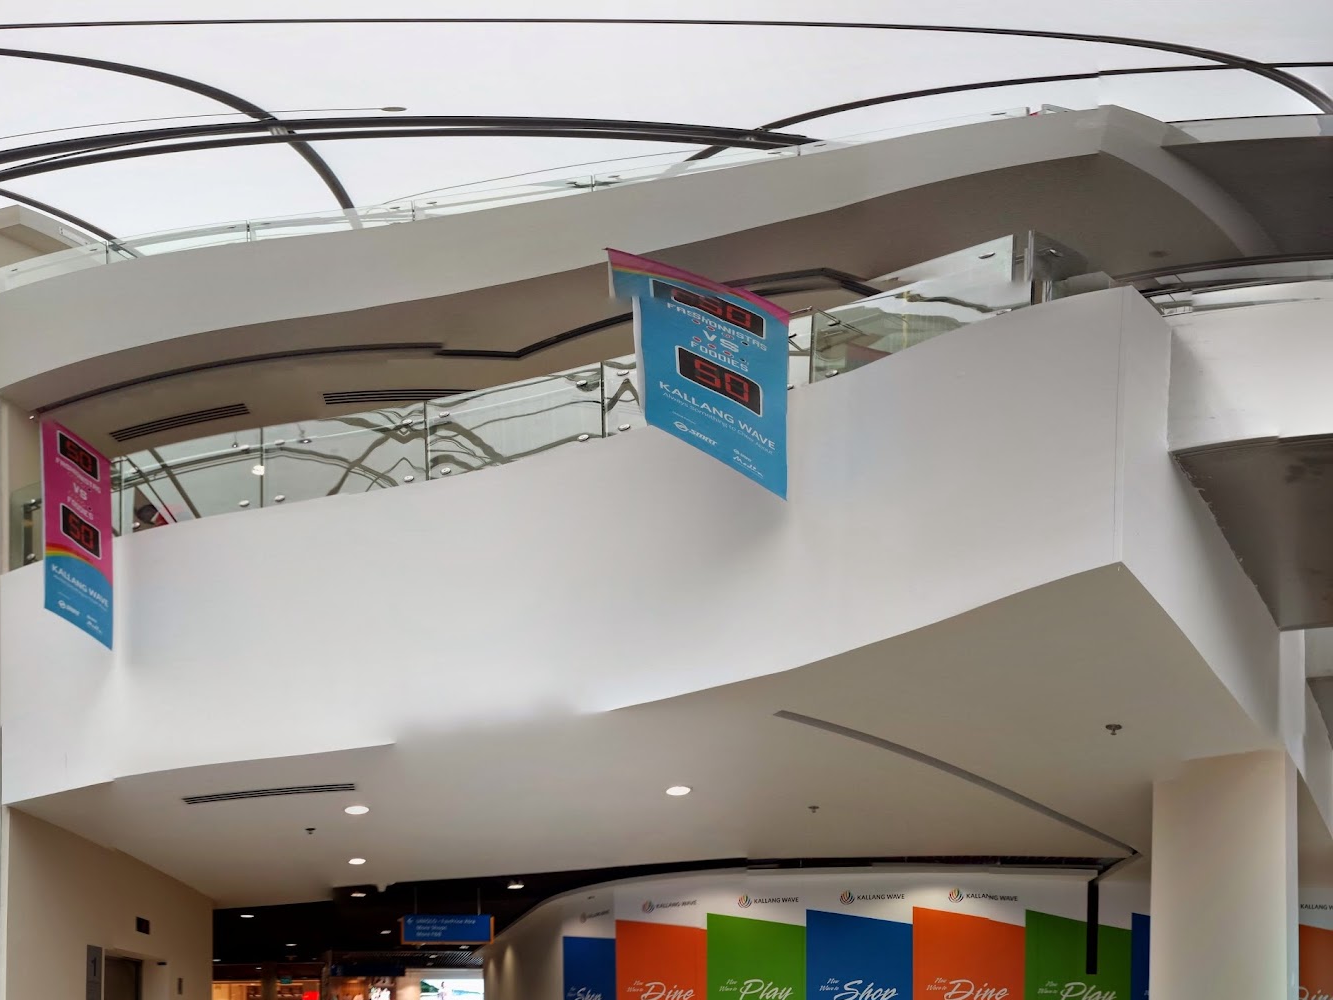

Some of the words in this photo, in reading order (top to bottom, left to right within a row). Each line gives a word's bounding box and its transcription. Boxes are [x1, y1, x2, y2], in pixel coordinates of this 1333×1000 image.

[690, 341, 749, 372] FOODIES
[702, 329, 740, 353] VS
[694, 359, 749, 402] 50
[659, 381, 735, 424] KALLANG
[738, 420, 776, 451] WAVE
[68, 513, 93, 549] 50
